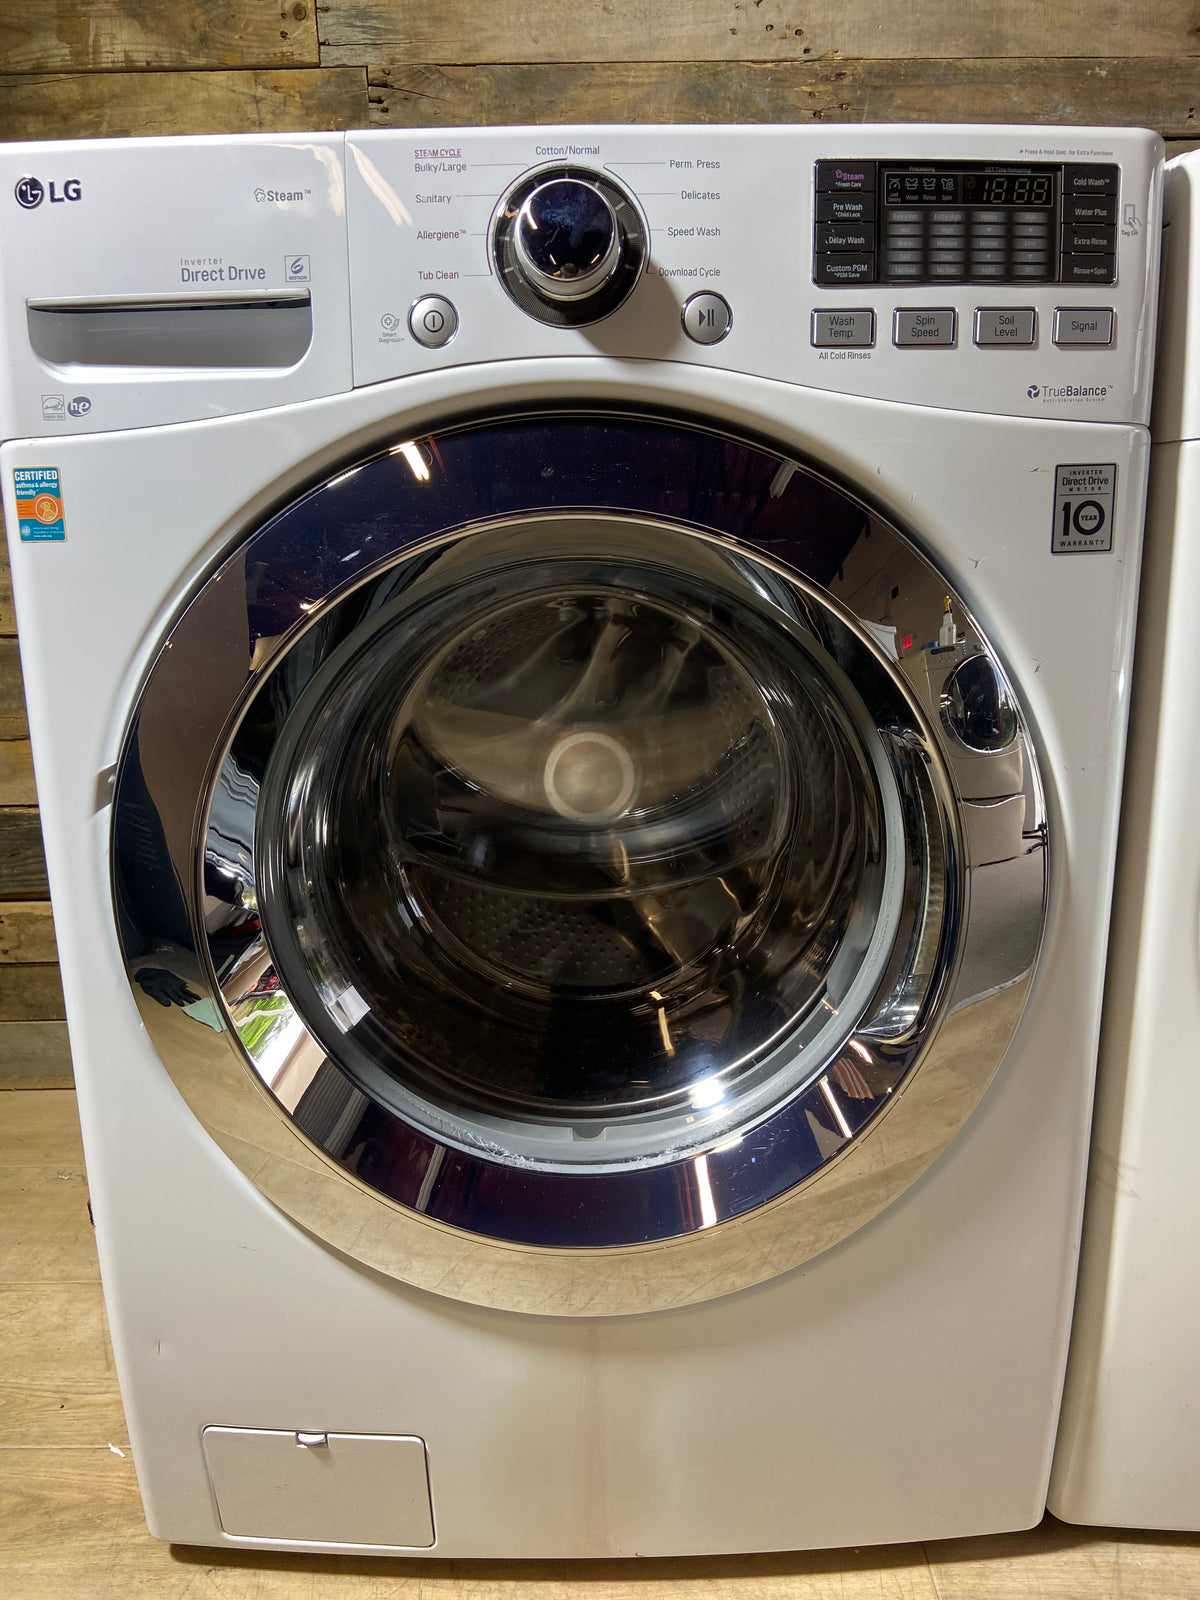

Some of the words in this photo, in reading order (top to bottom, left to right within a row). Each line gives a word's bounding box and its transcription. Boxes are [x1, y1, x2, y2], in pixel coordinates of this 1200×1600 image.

[414, 149, 439, 157] STEAM
[440, 149, 462, 157] CYCLE
[535, 146, 600, 156] Cotton/Normal
[414, 163, 467, 173] Bulky/Large
[669, 160, 694, 169] Perm.
[696, 160, 721, 169] Press
[843, 172, 865, 180] Steam
[1073, 178, 1087, 186] Cold
[48, 178, 82, 203] LG
[681, 190, 721, 200] Delicates
[833, 203, 844, 211] Pre
[845, 203, 863, 211] Wash
[1074, 208, 1093, 216] Water
[1094, 208, 1107, 216] Plus
[667, 226, 694, 237] Speed
[696, 226, 721, 236] Wash
[828, 237, 847, 245] Delay
[847, 236, 865, 244] Wash
[1074, 237, 1090, 245] Extra
[1091, 237, 1107, 245] Rinse
[180, 258, 223, 266] Inverter
[826, 264, 851, 272] Custom
[852, 263, 868, 272] PGM
[1073, 267, 1107, 275] Rinse+Spin
[181, 267, 225, 282] Direct
[228, 265, 266, 280] Drive
[418, 271, 434, 280] Tub
[436, 271, 459, 280] Clean
[659, 268, 697, 277] Download
[699, 268, 721, 279] Cycle
[829, 316, 855, 326] Wash
[915, 315, 936, 326] Spin
[998, 315, 1015, 325] Soil
[1071, 321, 1098, 332] Signal
[828, 328, 855, 339] Temp.
[911, 327, 939, 338] Speed
[994, 327, 1018, 337] Level
[819, 352, 829, 360] All
[830, 352, 846, 360] Cold
[847, 352, 872, 360] Rinses
[14, 470, 58, 481] CERTIFIED
[1062, 477, 1086, 486] Direct
[1088, 476, 1109, 485] Drive
[1062, 500, 1105, 536] 10
